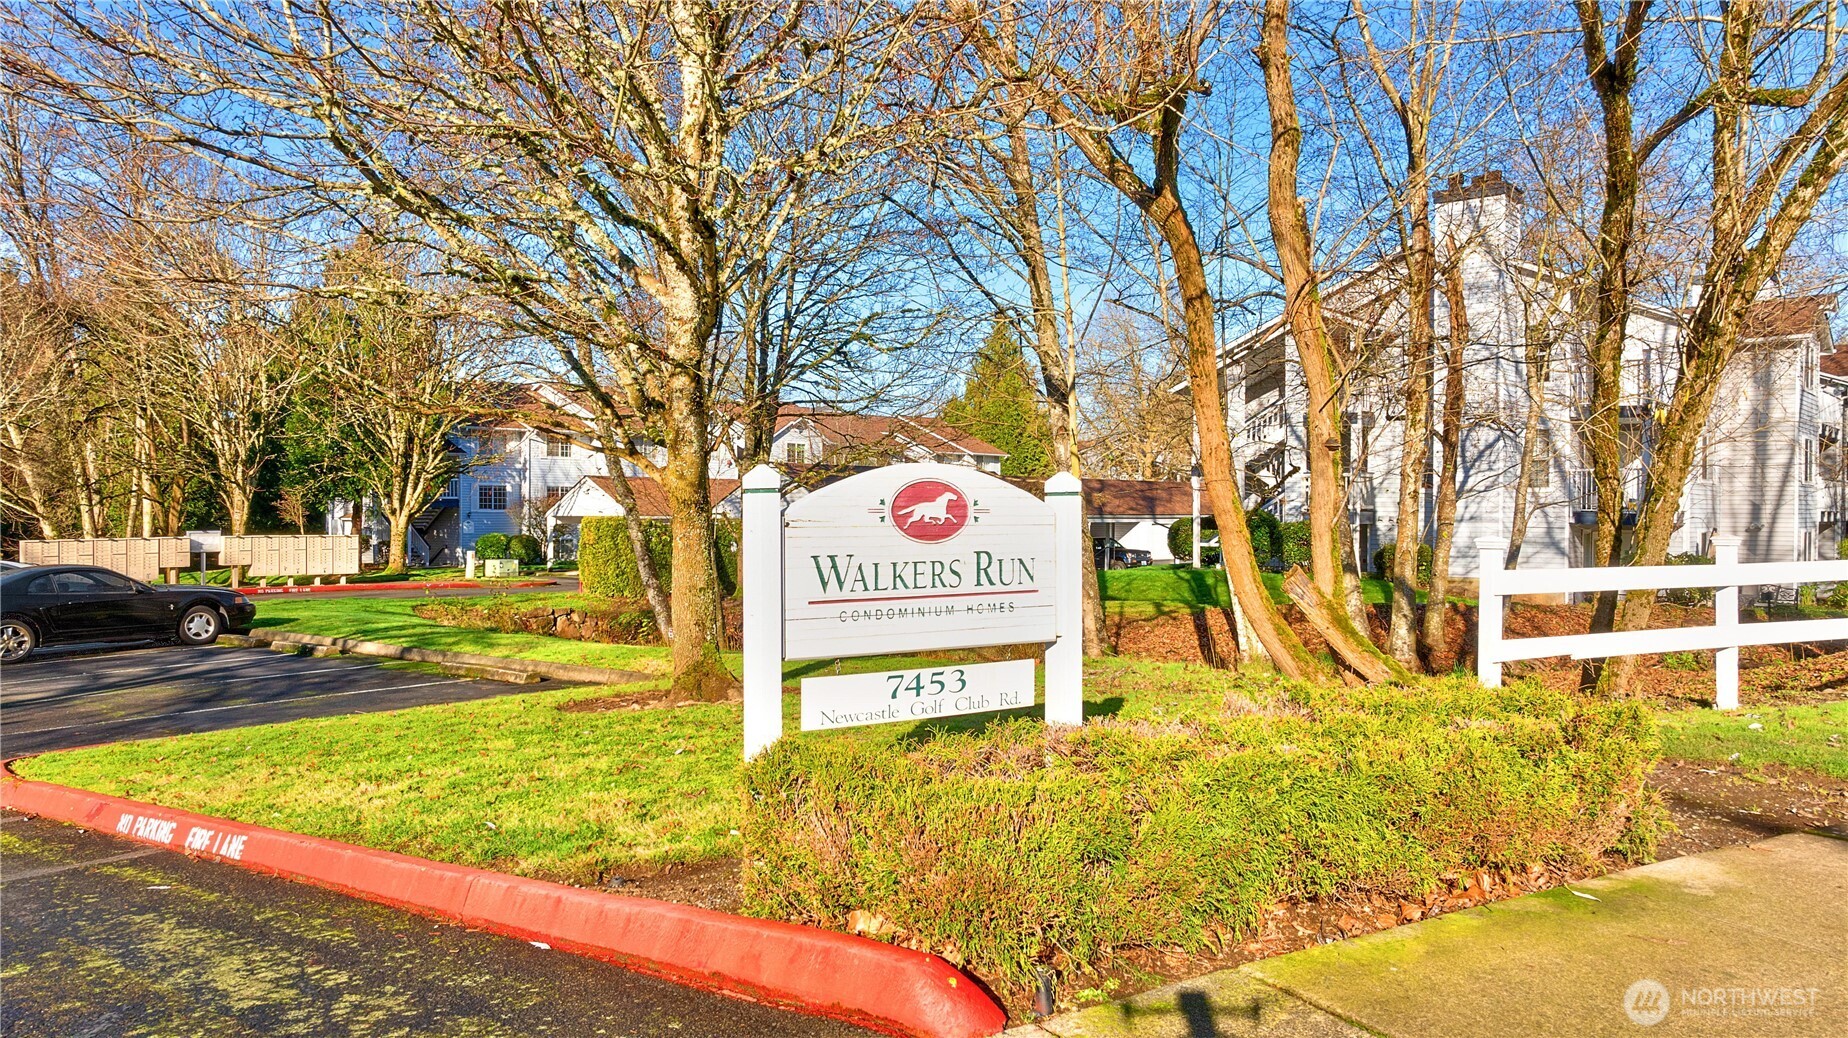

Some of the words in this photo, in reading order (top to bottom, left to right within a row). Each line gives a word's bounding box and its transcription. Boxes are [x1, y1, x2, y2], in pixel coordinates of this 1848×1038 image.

[810, 554, 963, 595] WALKERS
[973, 550, 1036, 587] RUN
[839, 605, 955, 623] CONDOMINIUM
[966, 601, 1015, 614] HOMES
[886, 668, 967, 700] 7453
[820, 704, 900, 726] Newcastle
[910, 698, 945, 716] Golf
[954, 694, 990, 712] Club
[999, 691, 1022, 707] Rd.
[116, 813, 134, 835] NO
[132, 816, 177, 844] PARKING
